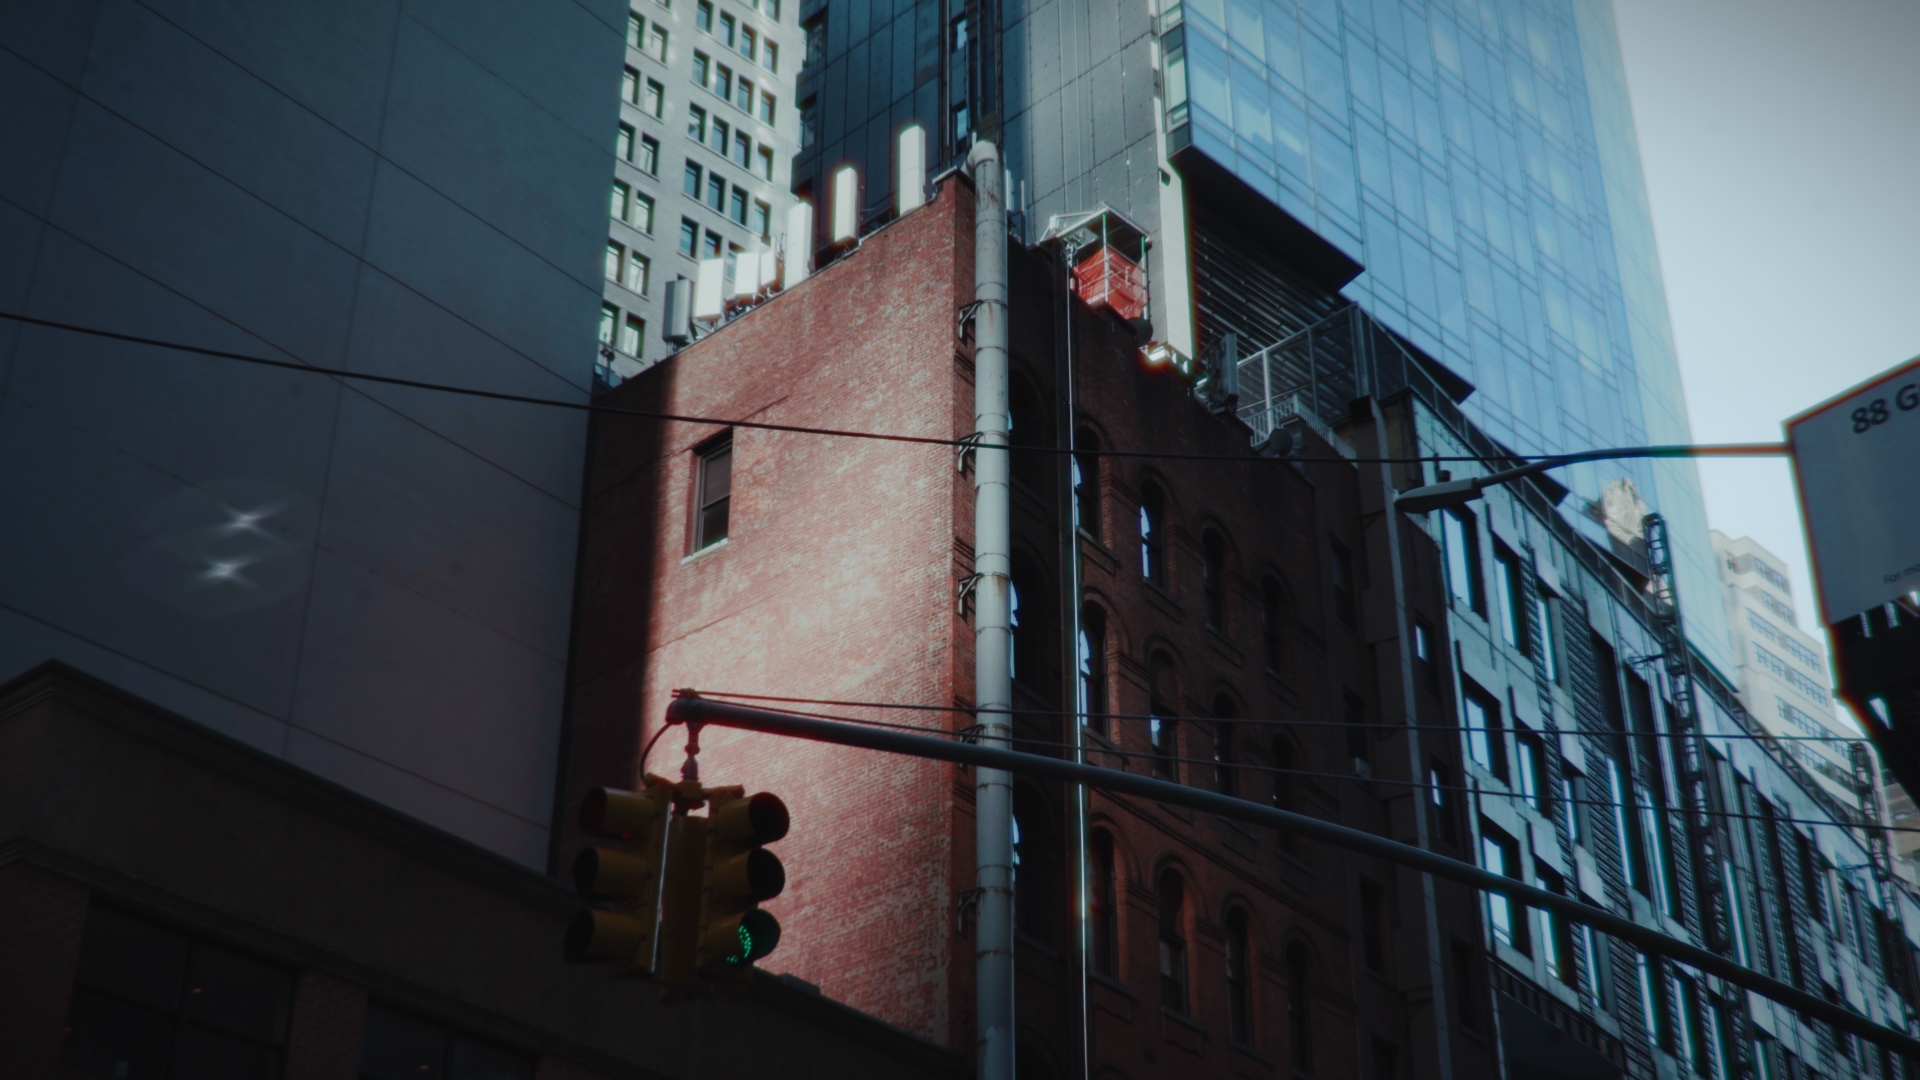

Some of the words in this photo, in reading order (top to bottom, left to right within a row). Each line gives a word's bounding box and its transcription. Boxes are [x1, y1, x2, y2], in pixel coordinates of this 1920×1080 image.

[1851, 398, 1889, 434] 88
[1895, 383, 1920, 412] G
[1883, 571, 1903, 585] For
